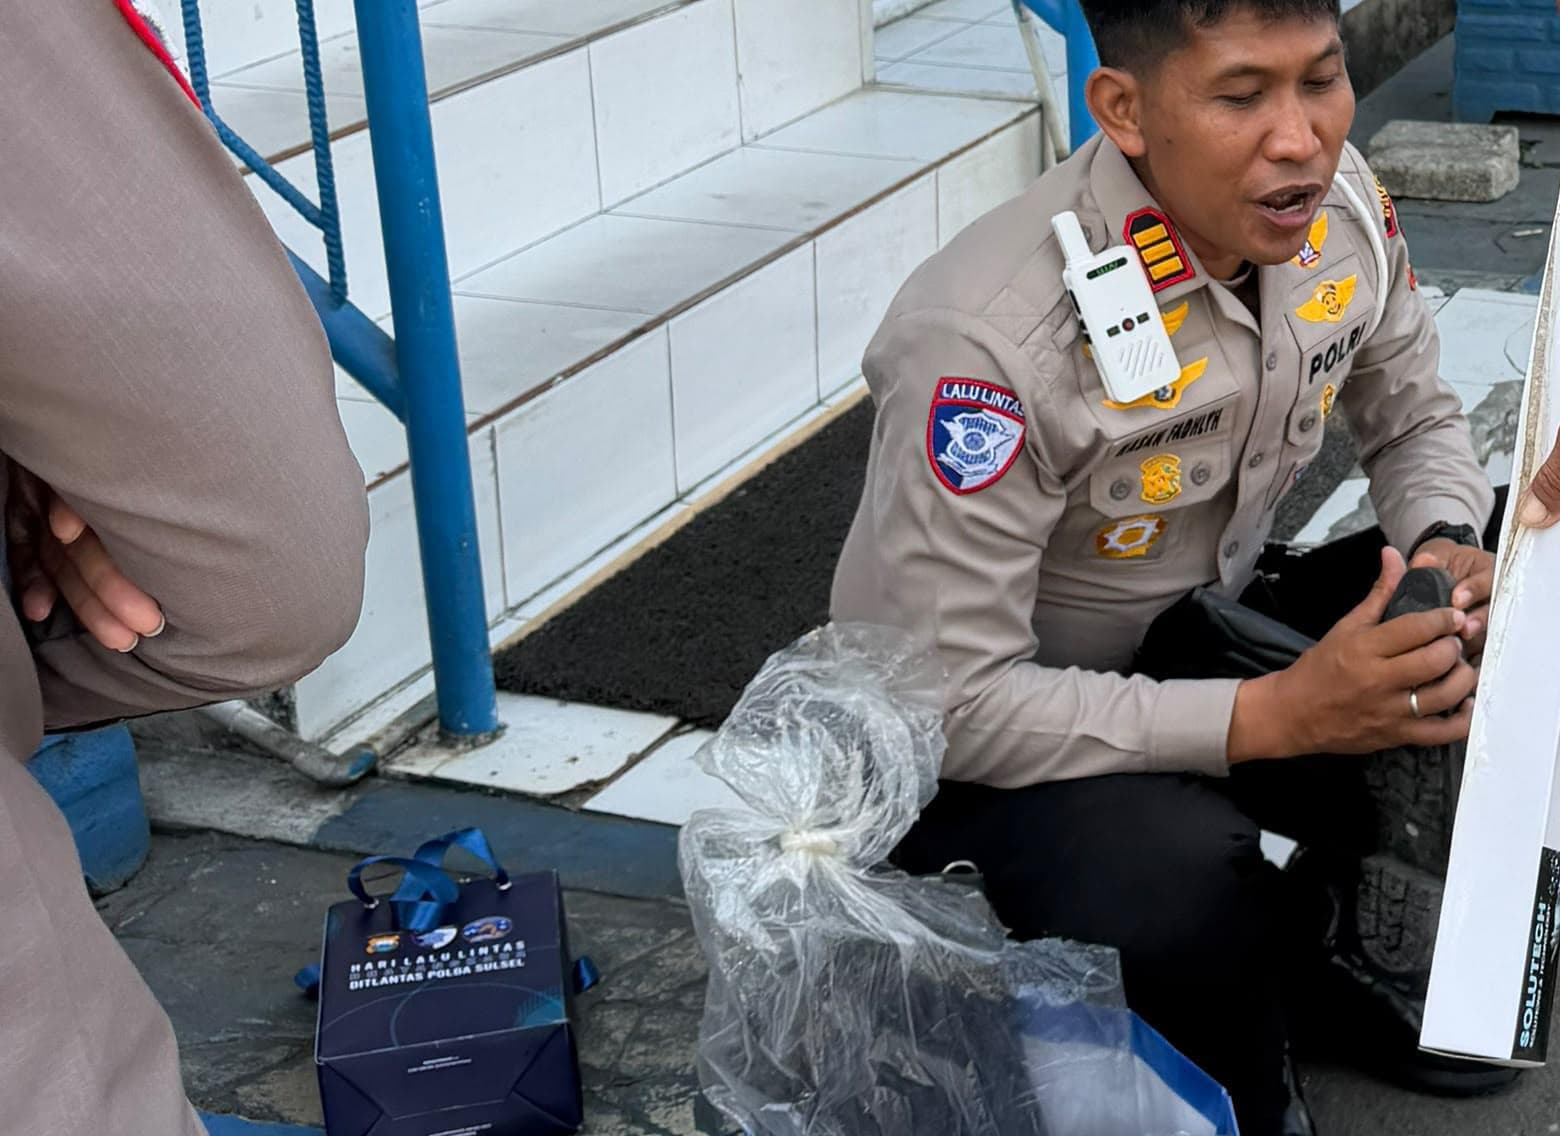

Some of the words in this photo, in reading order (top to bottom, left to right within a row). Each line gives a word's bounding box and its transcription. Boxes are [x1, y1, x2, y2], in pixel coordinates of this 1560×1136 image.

[1309, 321, 1366, 384] POLRI
[942, 383, 980, 400] LALU
[349, 972, 424, 990] DITLANTAS
[427, 965, 471, 980] POLDA
[474, 957, 525, 973] SULSEL
[351, 959, 396, 973] HARI
[404, 952, 450, 966] LALU
[458, 941, 525, 960] LINTAS
[1520, 902, 1547, 1048] SOLUTECH
